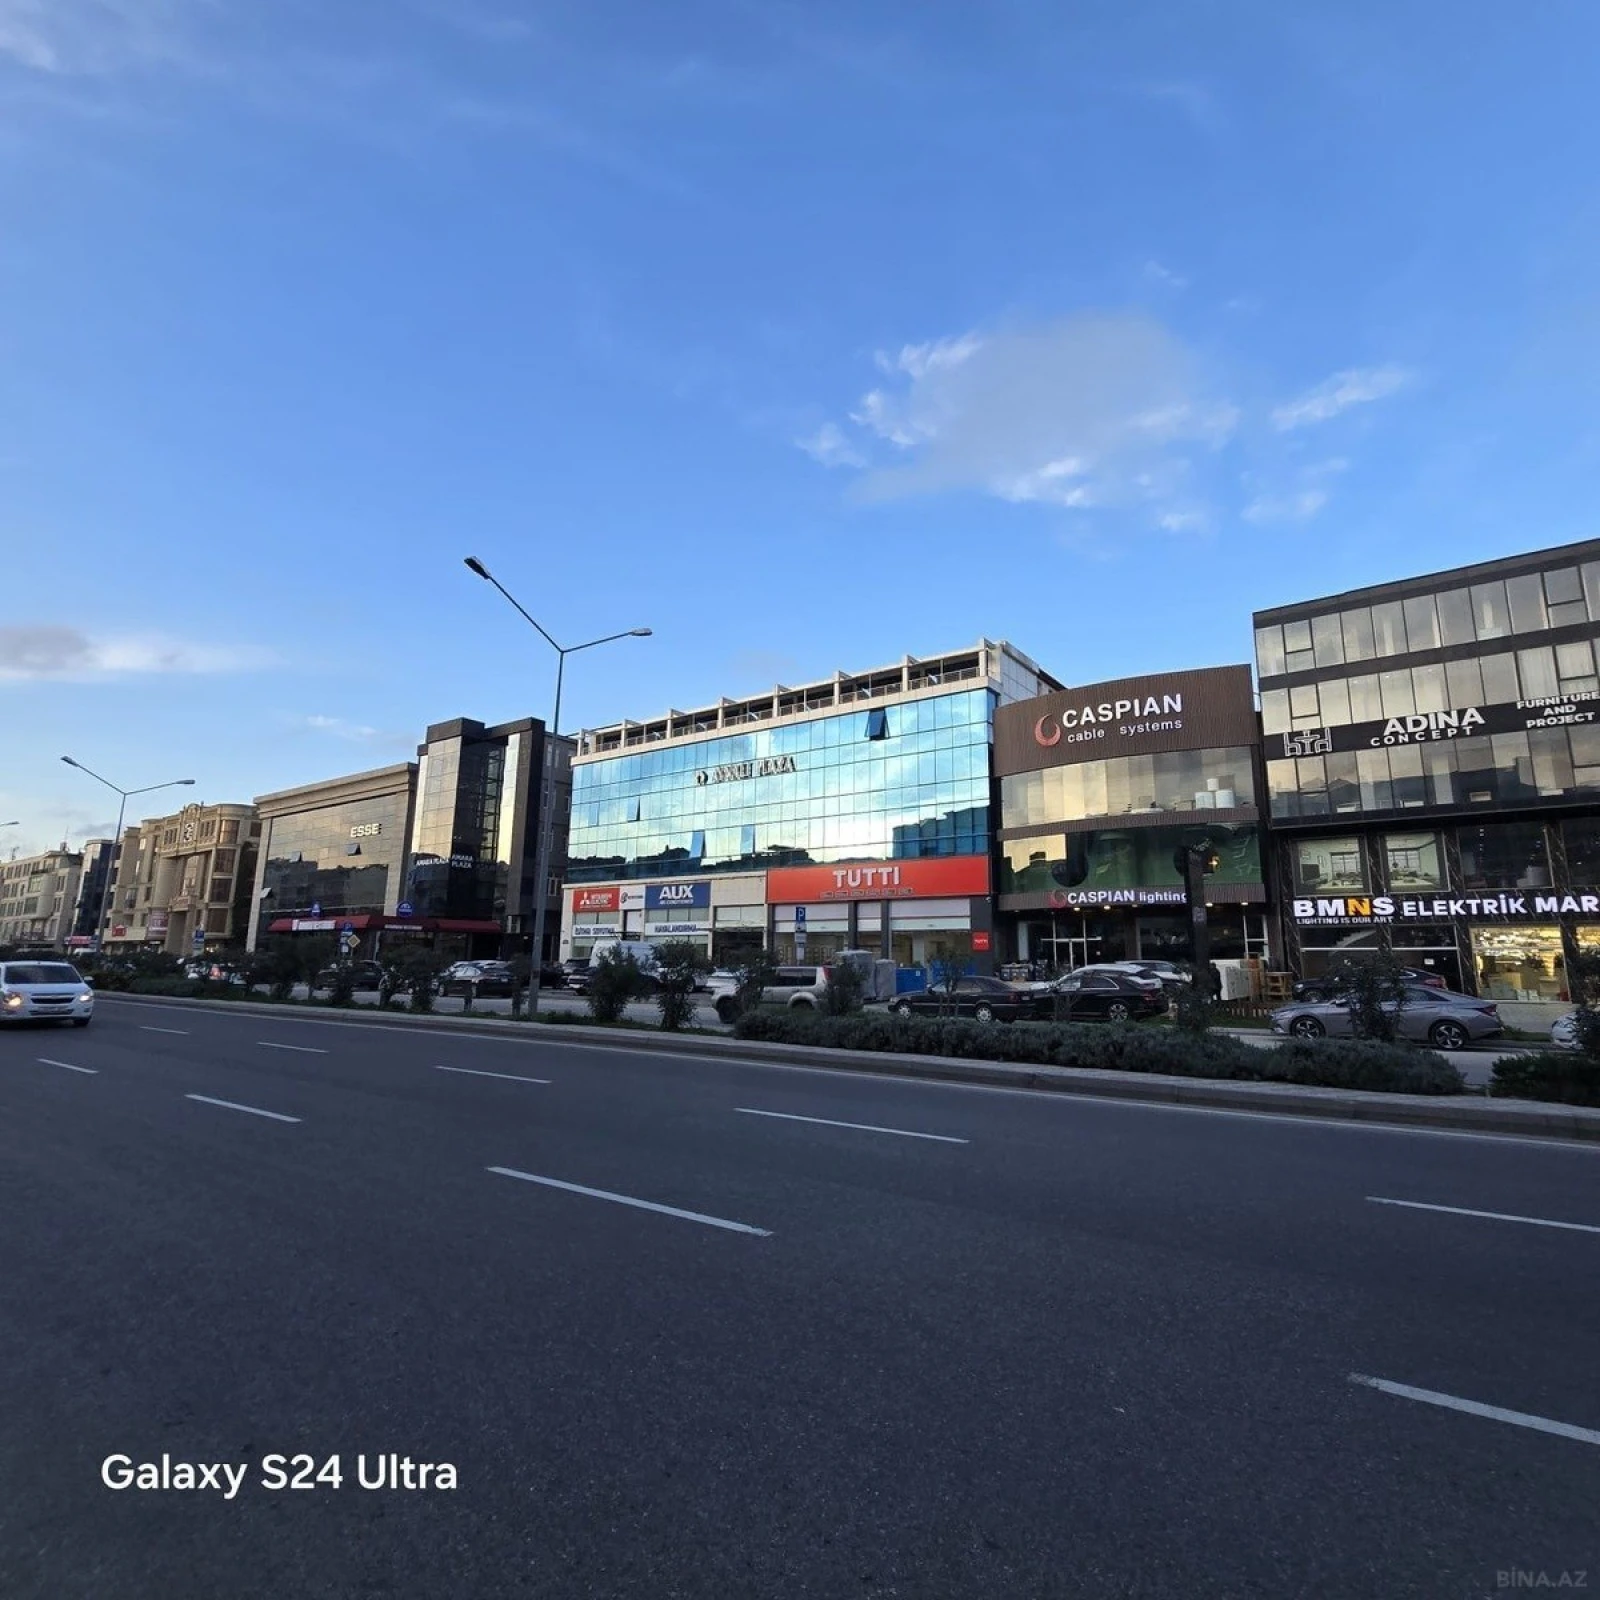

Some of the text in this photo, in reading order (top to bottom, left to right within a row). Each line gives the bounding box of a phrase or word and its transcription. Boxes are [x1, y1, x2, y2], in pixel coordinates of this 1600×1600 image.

[1516, 691, 1600, 710] FURNITURE
[1062, 693, 1182, 728] CASPIAN
[1526, 711, 1596, 729] PROJECT
[1543, 704, 1577, 717] AND
[1067, 719, 1182, 743] cable systems
[1383, 707, 1486, 736] ADINA
[1370, 726, 1473, 746] CONCEPT
[350, 823, 380, 838] ESSE
[832, 866, 899, 888] TUTTI
[659, 884, 694, 900] AUX
[1067, 889, 1134, 904] CASPIAN
[1293, 894, 1600, 917] BMNS ELEKTRİK MAR
[1296, 917, 1340, 925] LIGHTING
[1351, 916, 1372, 924] OUR
[1373, 915, 1395, 923] ART
